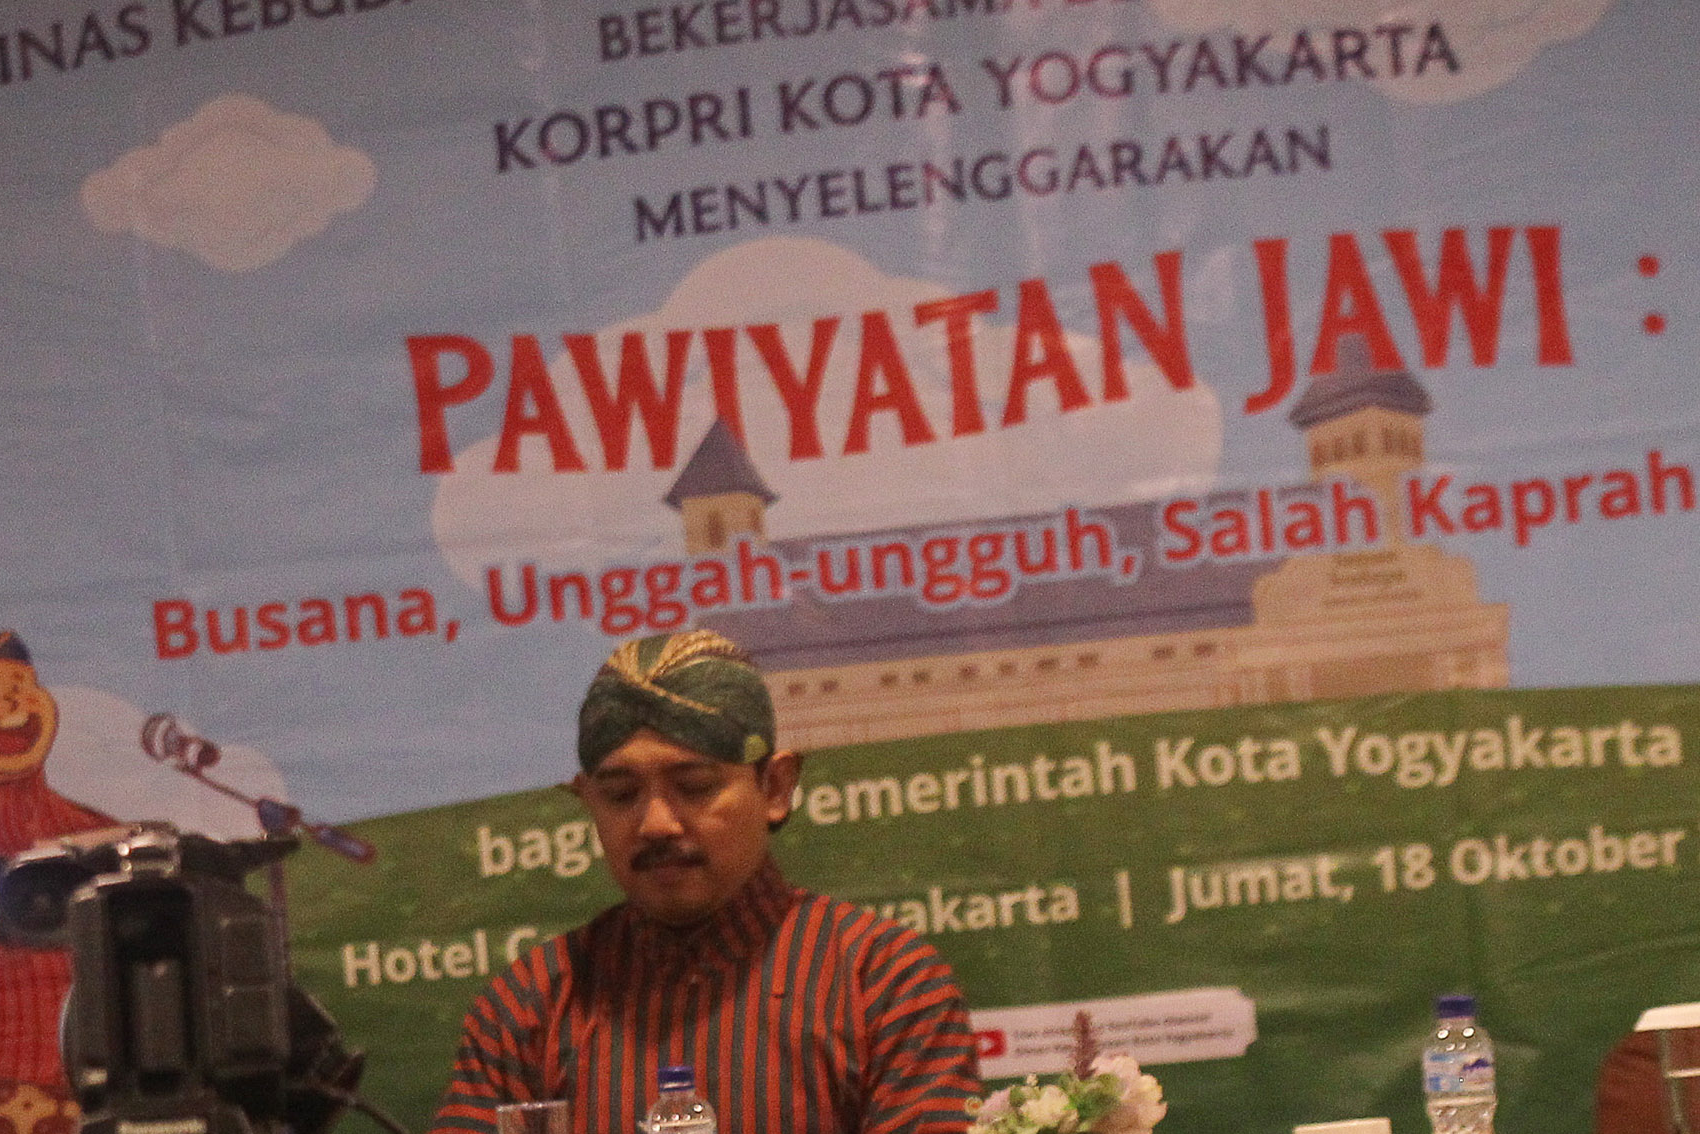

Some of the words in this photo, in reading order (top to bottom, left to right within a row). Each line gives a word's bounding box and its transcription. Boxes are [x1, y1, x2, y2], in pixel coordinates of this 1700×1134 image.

[172, 0, 393, 48] KEB
[597, 0, 1040, 62] BEKERJAS
[492, 86, 754, 175] KORPRI
[776, 61, 963, 135] KOTA
[978, 20, 1463, 112] YOGYAKARTA
[632, 124, 1333, 244] MENYELENGGARAKAN
[406, 250, 1196, 475] PAWIYATAN
[1244, 225, 1573, 415] JAWI
[153, 588, 459, 660] Busana,
[487, 507, 1135, 636] Unggah-ungguh,
[1162, 481, 1380, 563] Salah
[1407, 450, 1696, 547] Kaprah
[1153, 734, 1304, 792] Kota
[1310, 713, 1684, 791] Yogyakarta
[340, 928, 490, 988] Hotel
[861, 885, 1080, 934] akarta
[1164, 852, 1356, 925] Jumat,
[1368, 841, 1438, 893] 18
[1448, 823, 1687, 887] Oktober
